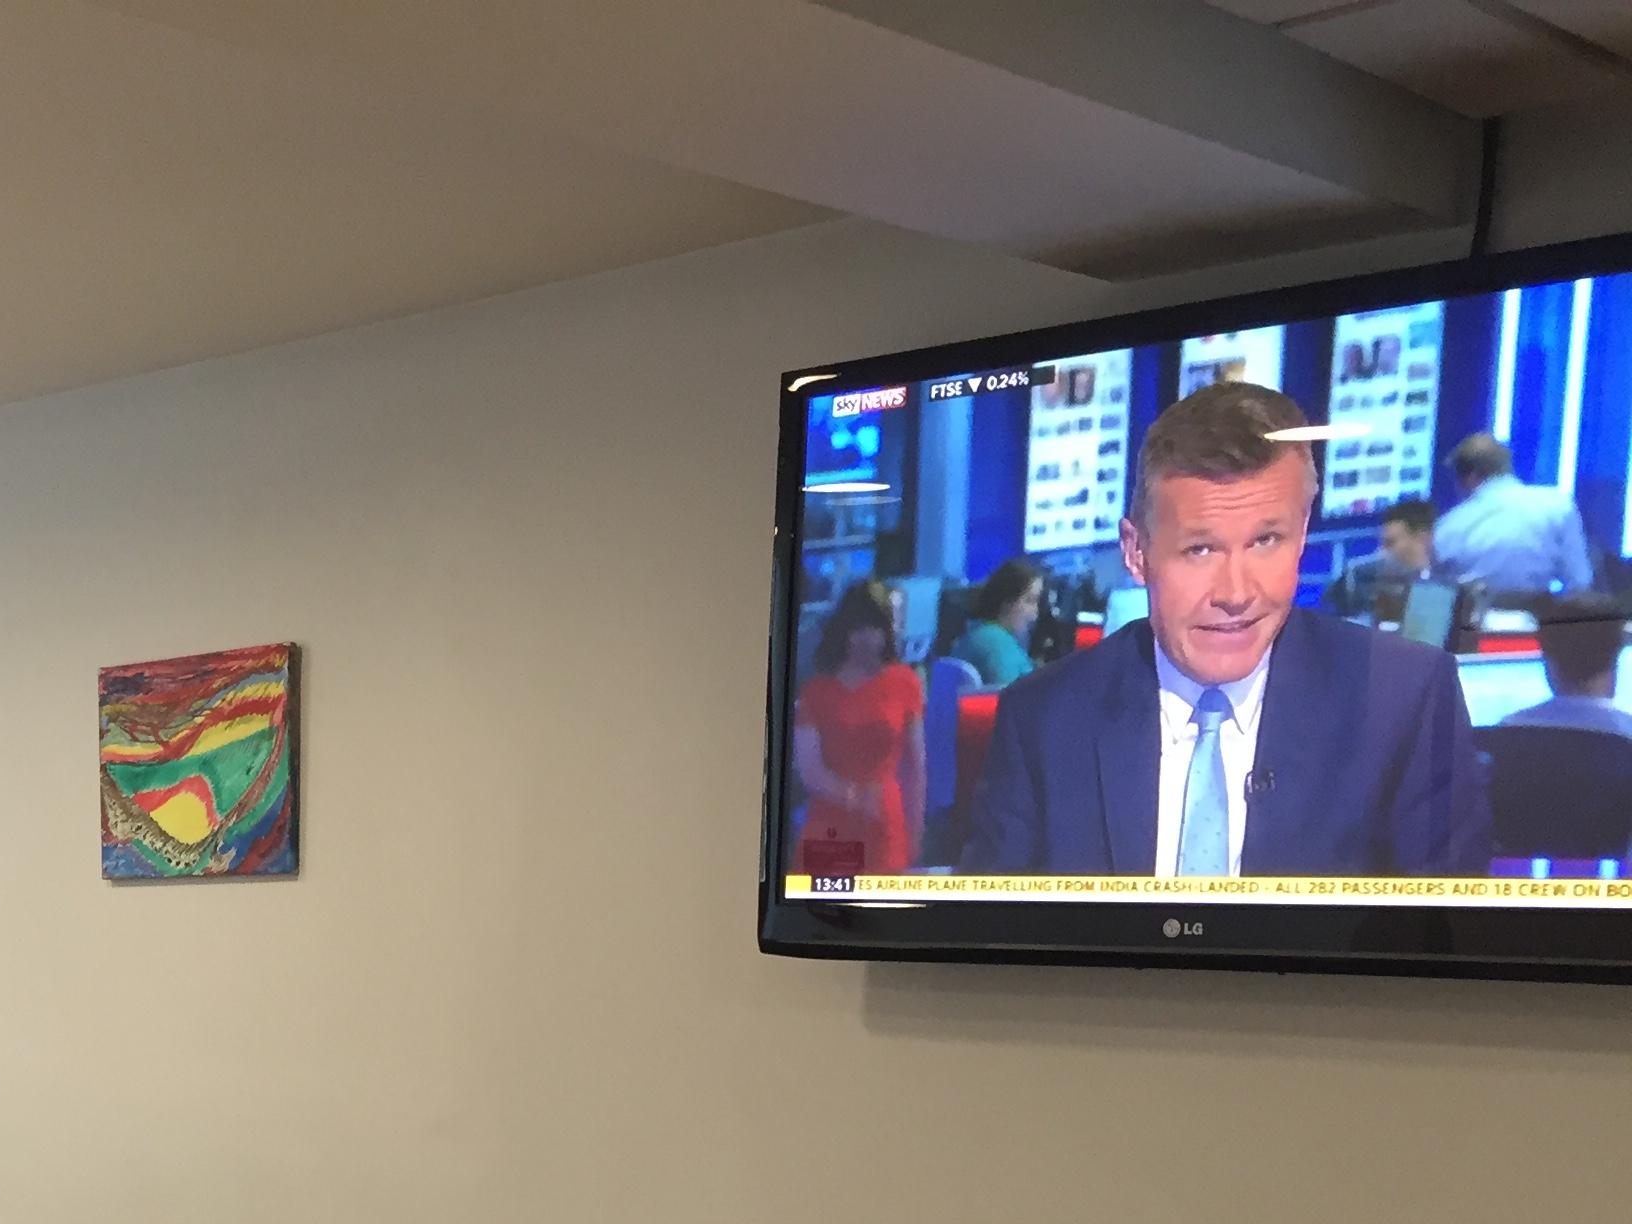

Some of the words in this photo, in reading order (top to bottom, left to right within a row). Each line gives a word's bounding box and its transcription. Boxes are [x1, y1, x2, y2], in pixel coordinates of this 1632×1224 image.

[930, 381, 963, 399] FTSE
[985, 371, 1030, 391] 0.24%
[835, 397, 858, 413] sky
[860, 388, 906, 411] NEWS
[815, 877, 851, 892] 13:41
[876, 879, 923, 890] AIRLINE
[927, 879, 967, 891] PLANE
[972, 880, 1052, 892] TRAVELLING
[1056, 880, 1095, 892] FROM
[1100, 881, 1138, 892] INDIA
[1275, 882, 1301, 894] ALL
[1309, 882, 1336, 894] 282
[1341, 882, 1446, 895] PASSENGERS
[1452, 883, 1488, 895] AND
[1494, 884, 1512, 896] 18
[1519, 884, 1567, 896] CREW
[1573, 884, 1600, 897] ON
[1183, 922, 1204, 935] LG
